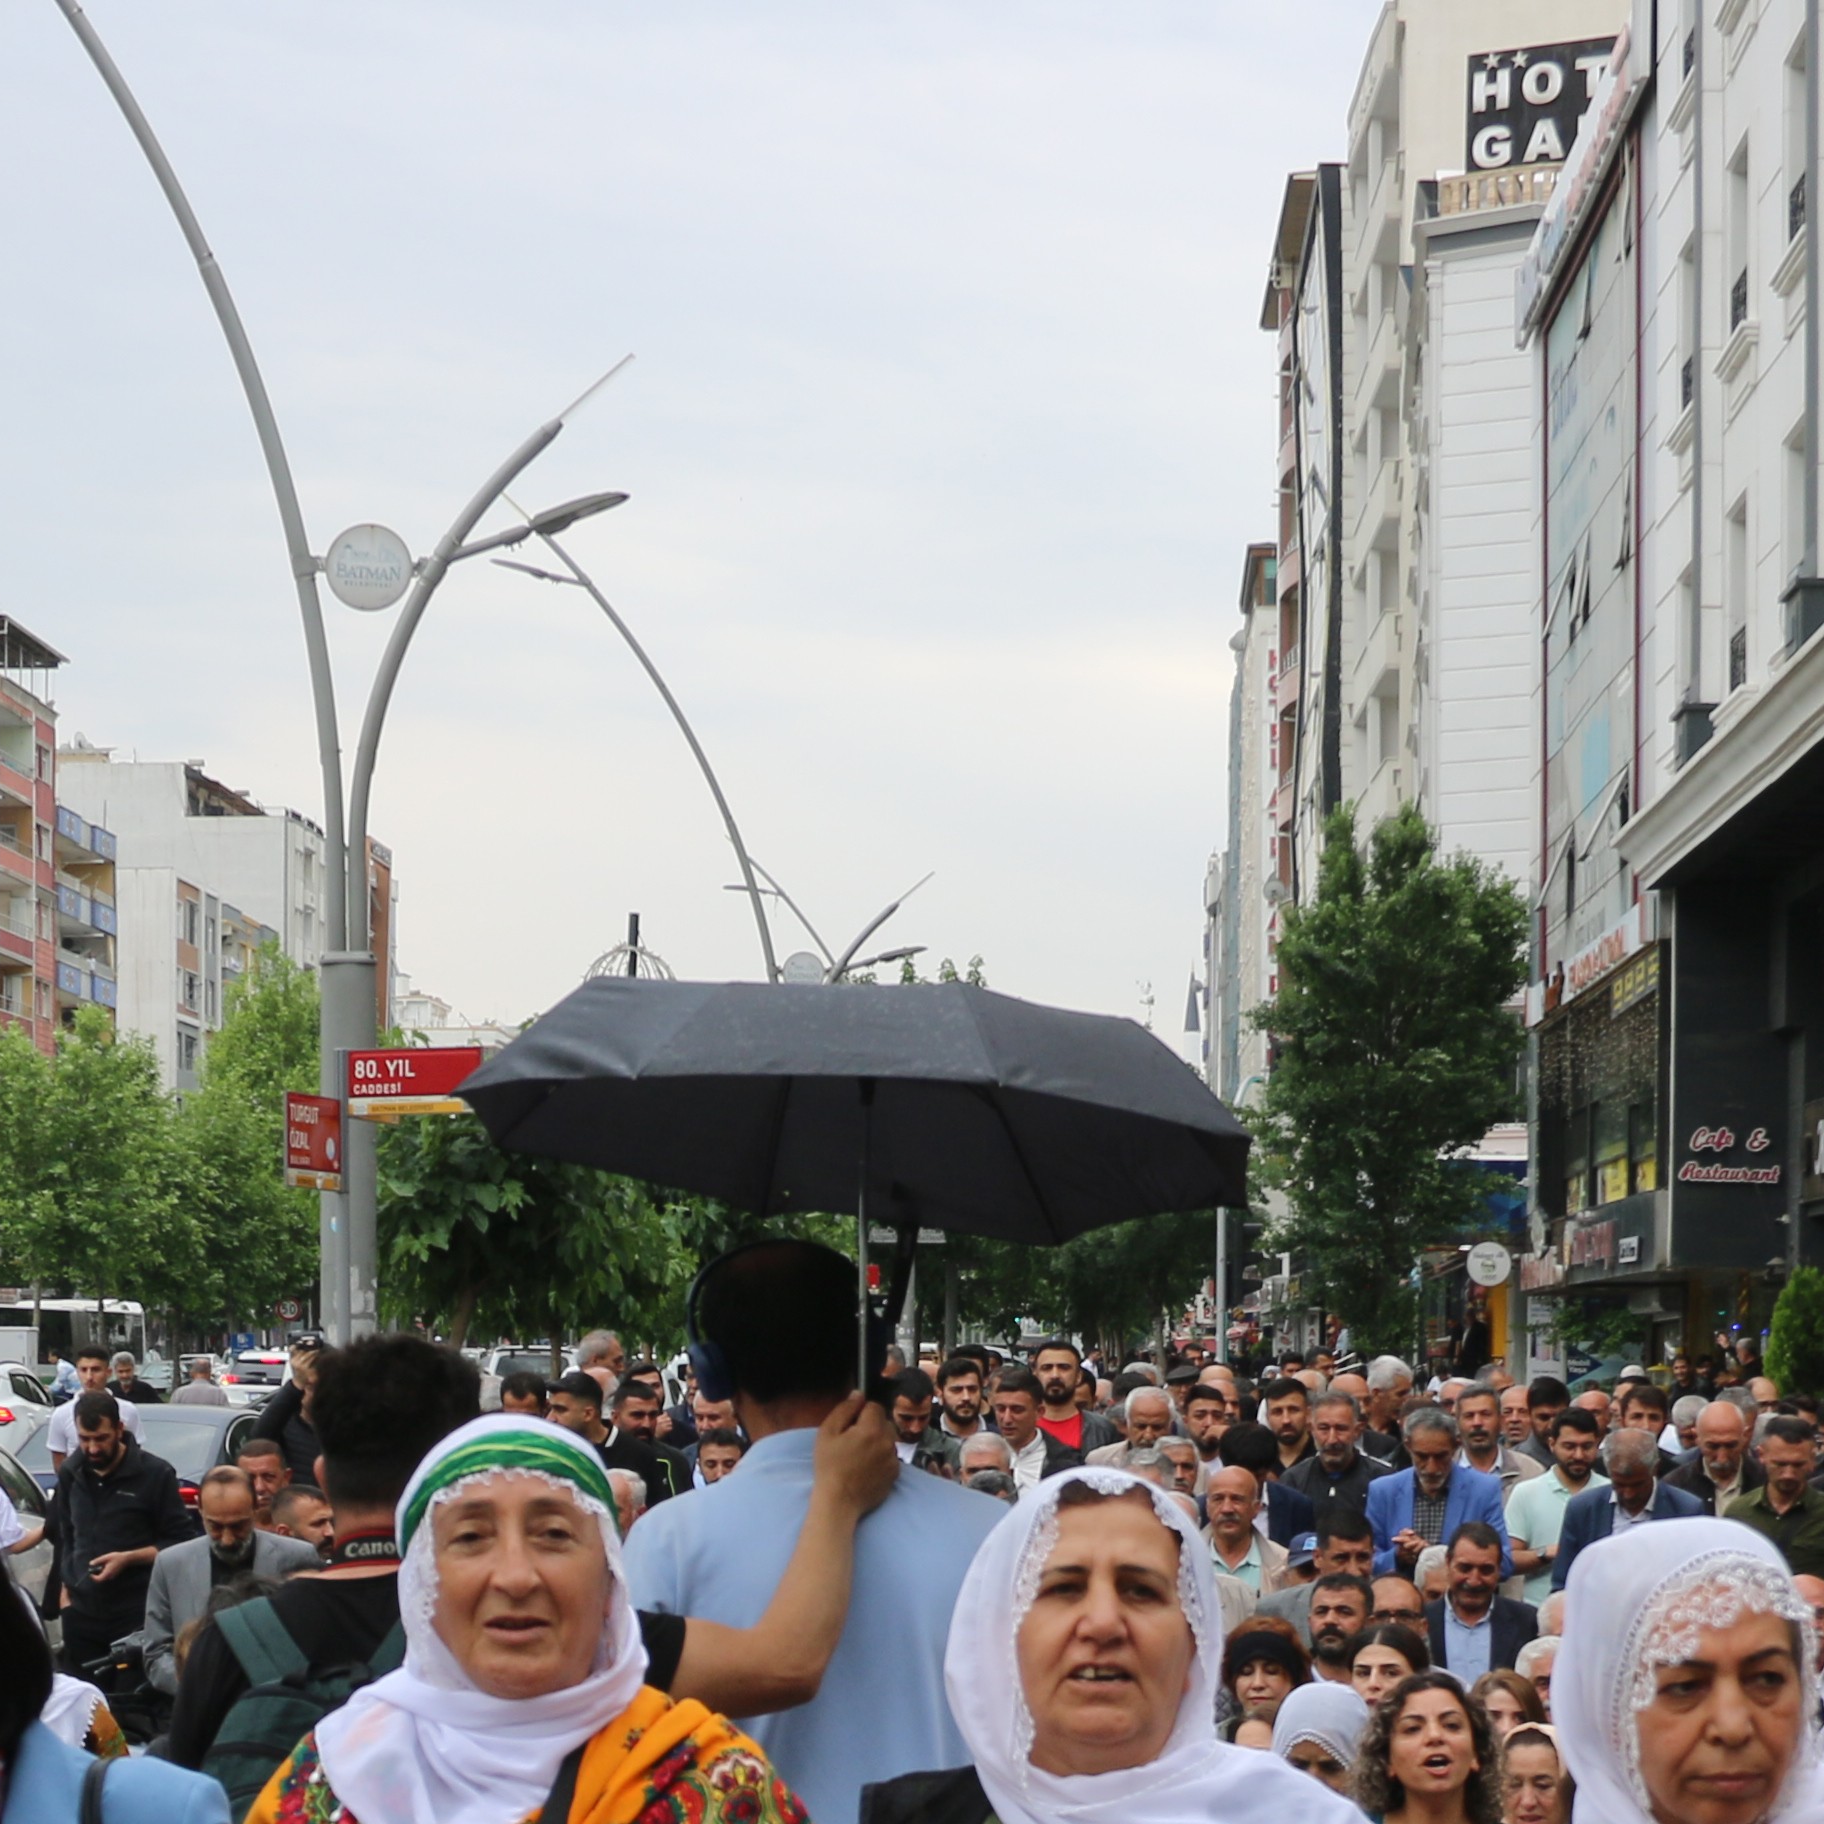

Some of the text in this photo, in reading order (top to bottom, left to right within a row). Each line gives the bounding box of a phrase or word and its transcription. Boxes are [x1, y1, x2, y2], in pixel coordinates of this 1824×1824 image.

[1472, 54, 1611, 113] HOT
[354, 1059, 416, 1079] 80. YIL
[353, 1082, 401, 1095] CADDESİ
[290, 1103, 320, 1125] TURGUT
[290, 1129, 310, 1150] ÖZAL
[1690, 1126, 1770, 1152] Cafe &
[1678, 1161, 1781, 1184] Restaurant
[344, 1541, 396, 1558] Cano
